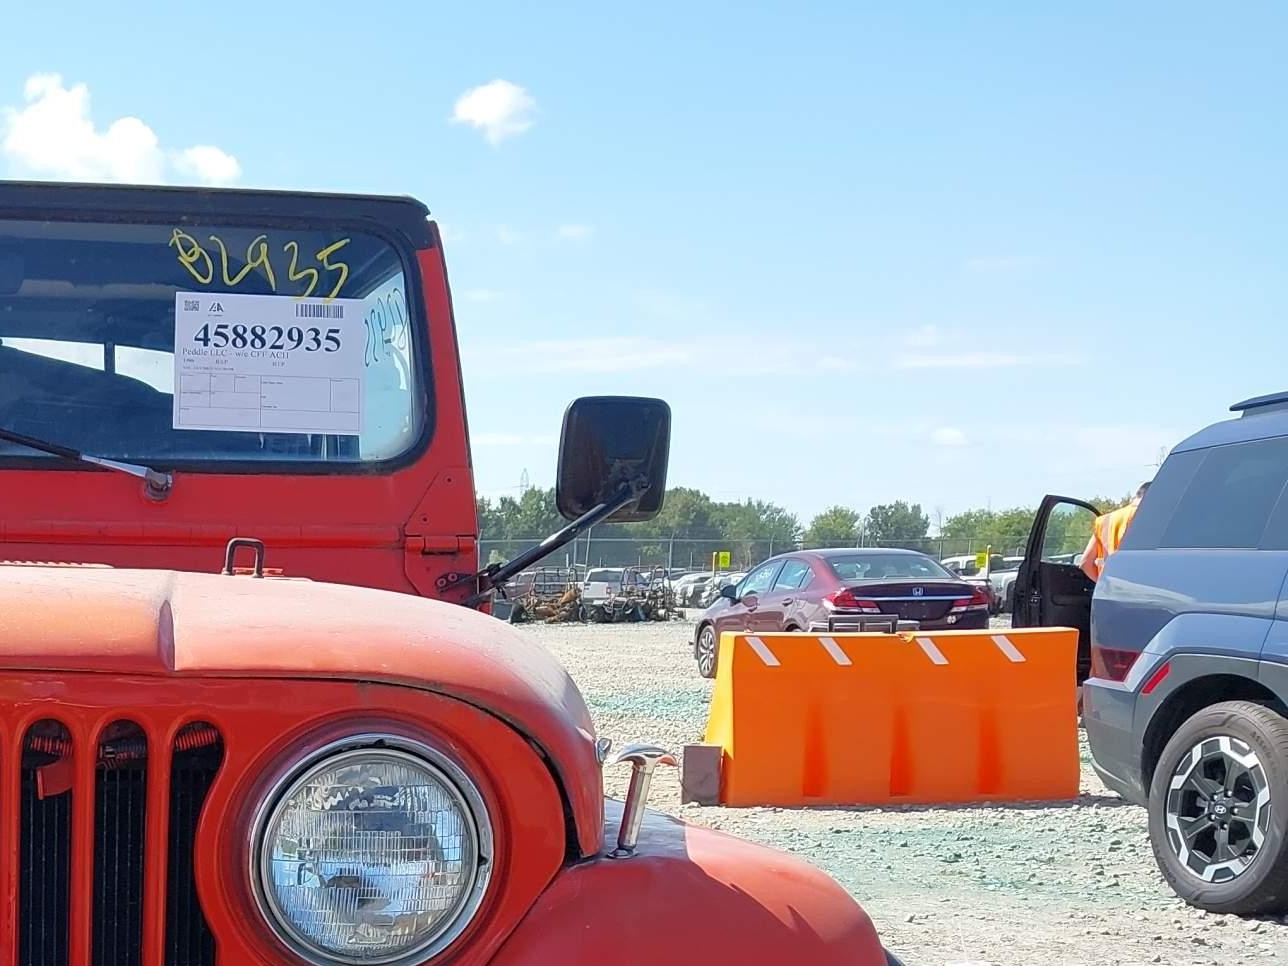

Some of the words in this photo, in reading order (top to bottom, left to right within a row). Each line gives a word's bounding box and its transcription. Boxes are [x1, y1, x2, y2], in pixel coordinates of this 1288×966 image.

[169, 228, 350, 302] B2935
[182, 348, 208, 356] Peddle
[210, 348, 227, 357] LLC
[193, 322, 342, 353] 45882935
